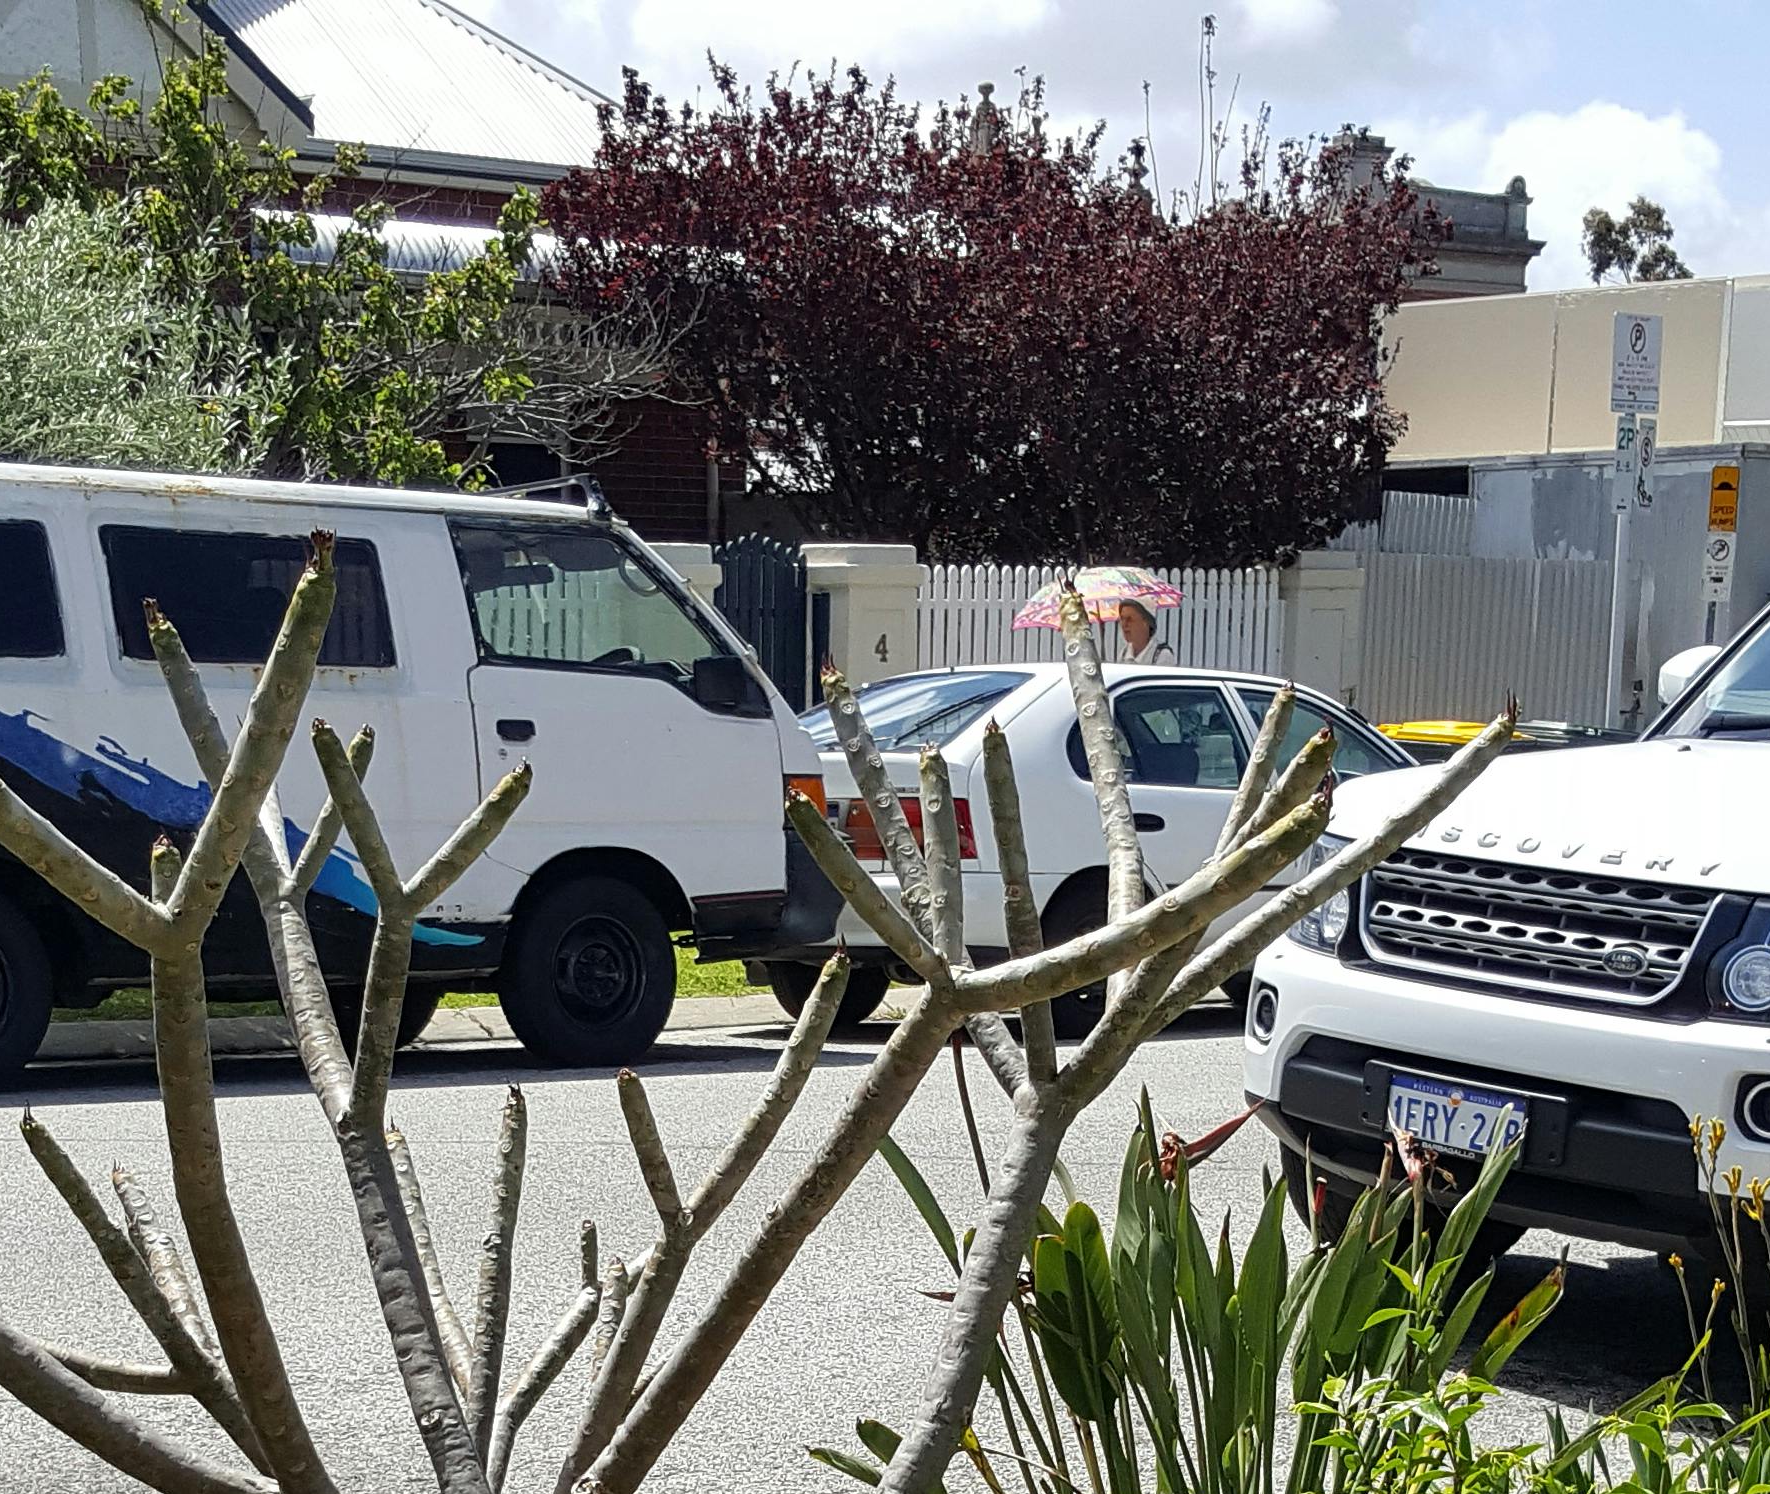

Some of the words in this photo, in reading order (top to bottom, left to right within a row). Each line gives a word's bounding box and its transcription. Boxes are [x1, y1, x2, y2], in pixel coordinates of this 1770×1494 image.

[1618, 427, 1635, 451] 2P
[1712, 504, 1736, 516] SPEED
[874, 633, 889, 663] 4
[1417, 822, 1722, 876] ISCOVERY
